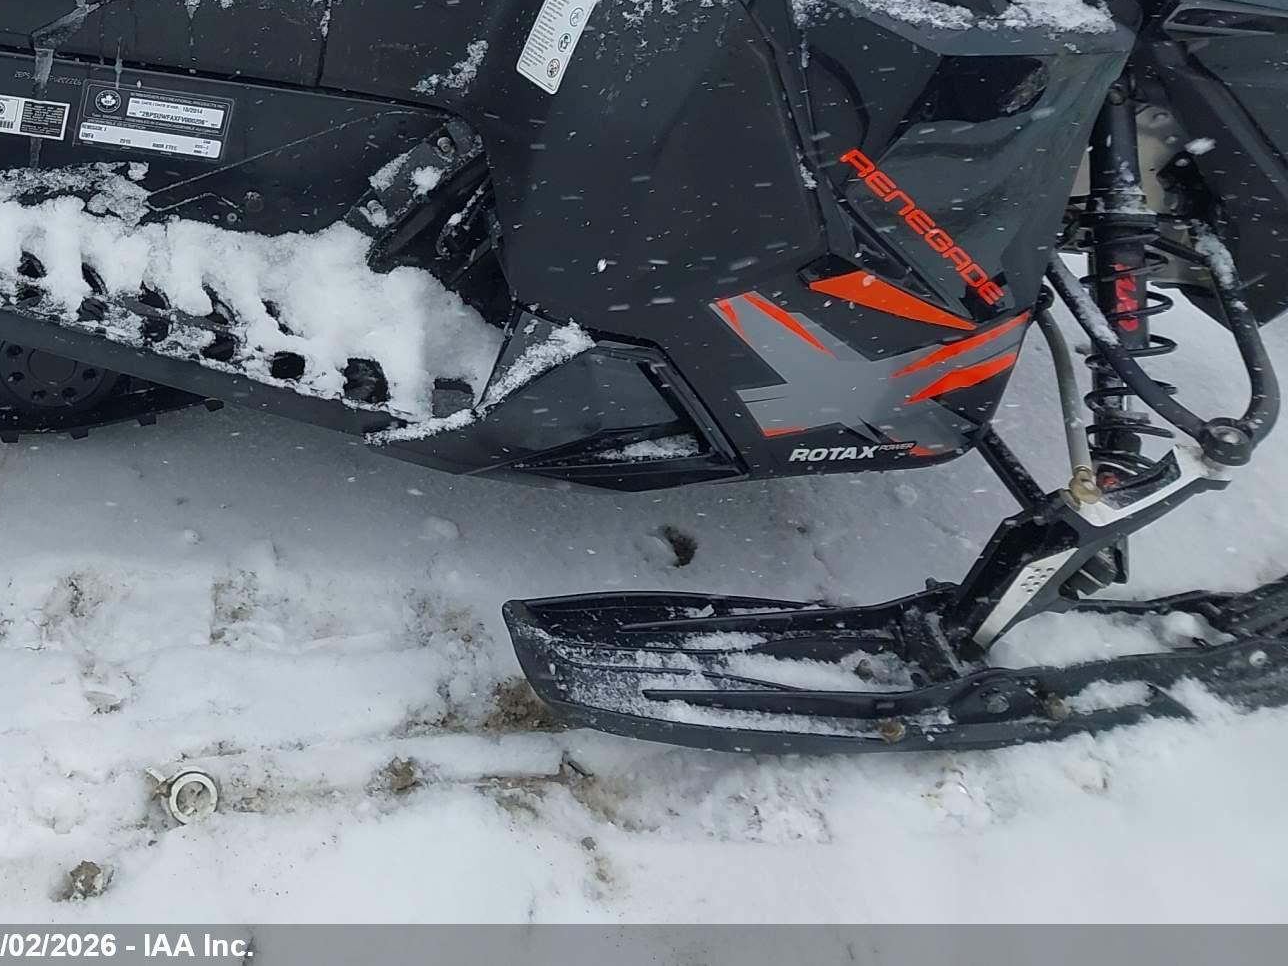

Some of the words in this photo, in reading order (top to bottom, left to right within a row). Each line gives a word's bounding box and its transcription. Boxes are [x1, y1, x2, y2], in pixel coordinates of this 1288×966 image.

[840, 148, 1005, 306] RENEGADE
[788, 445, 879, 461] ROTAX
[879, 442, 916, 451] POWER
